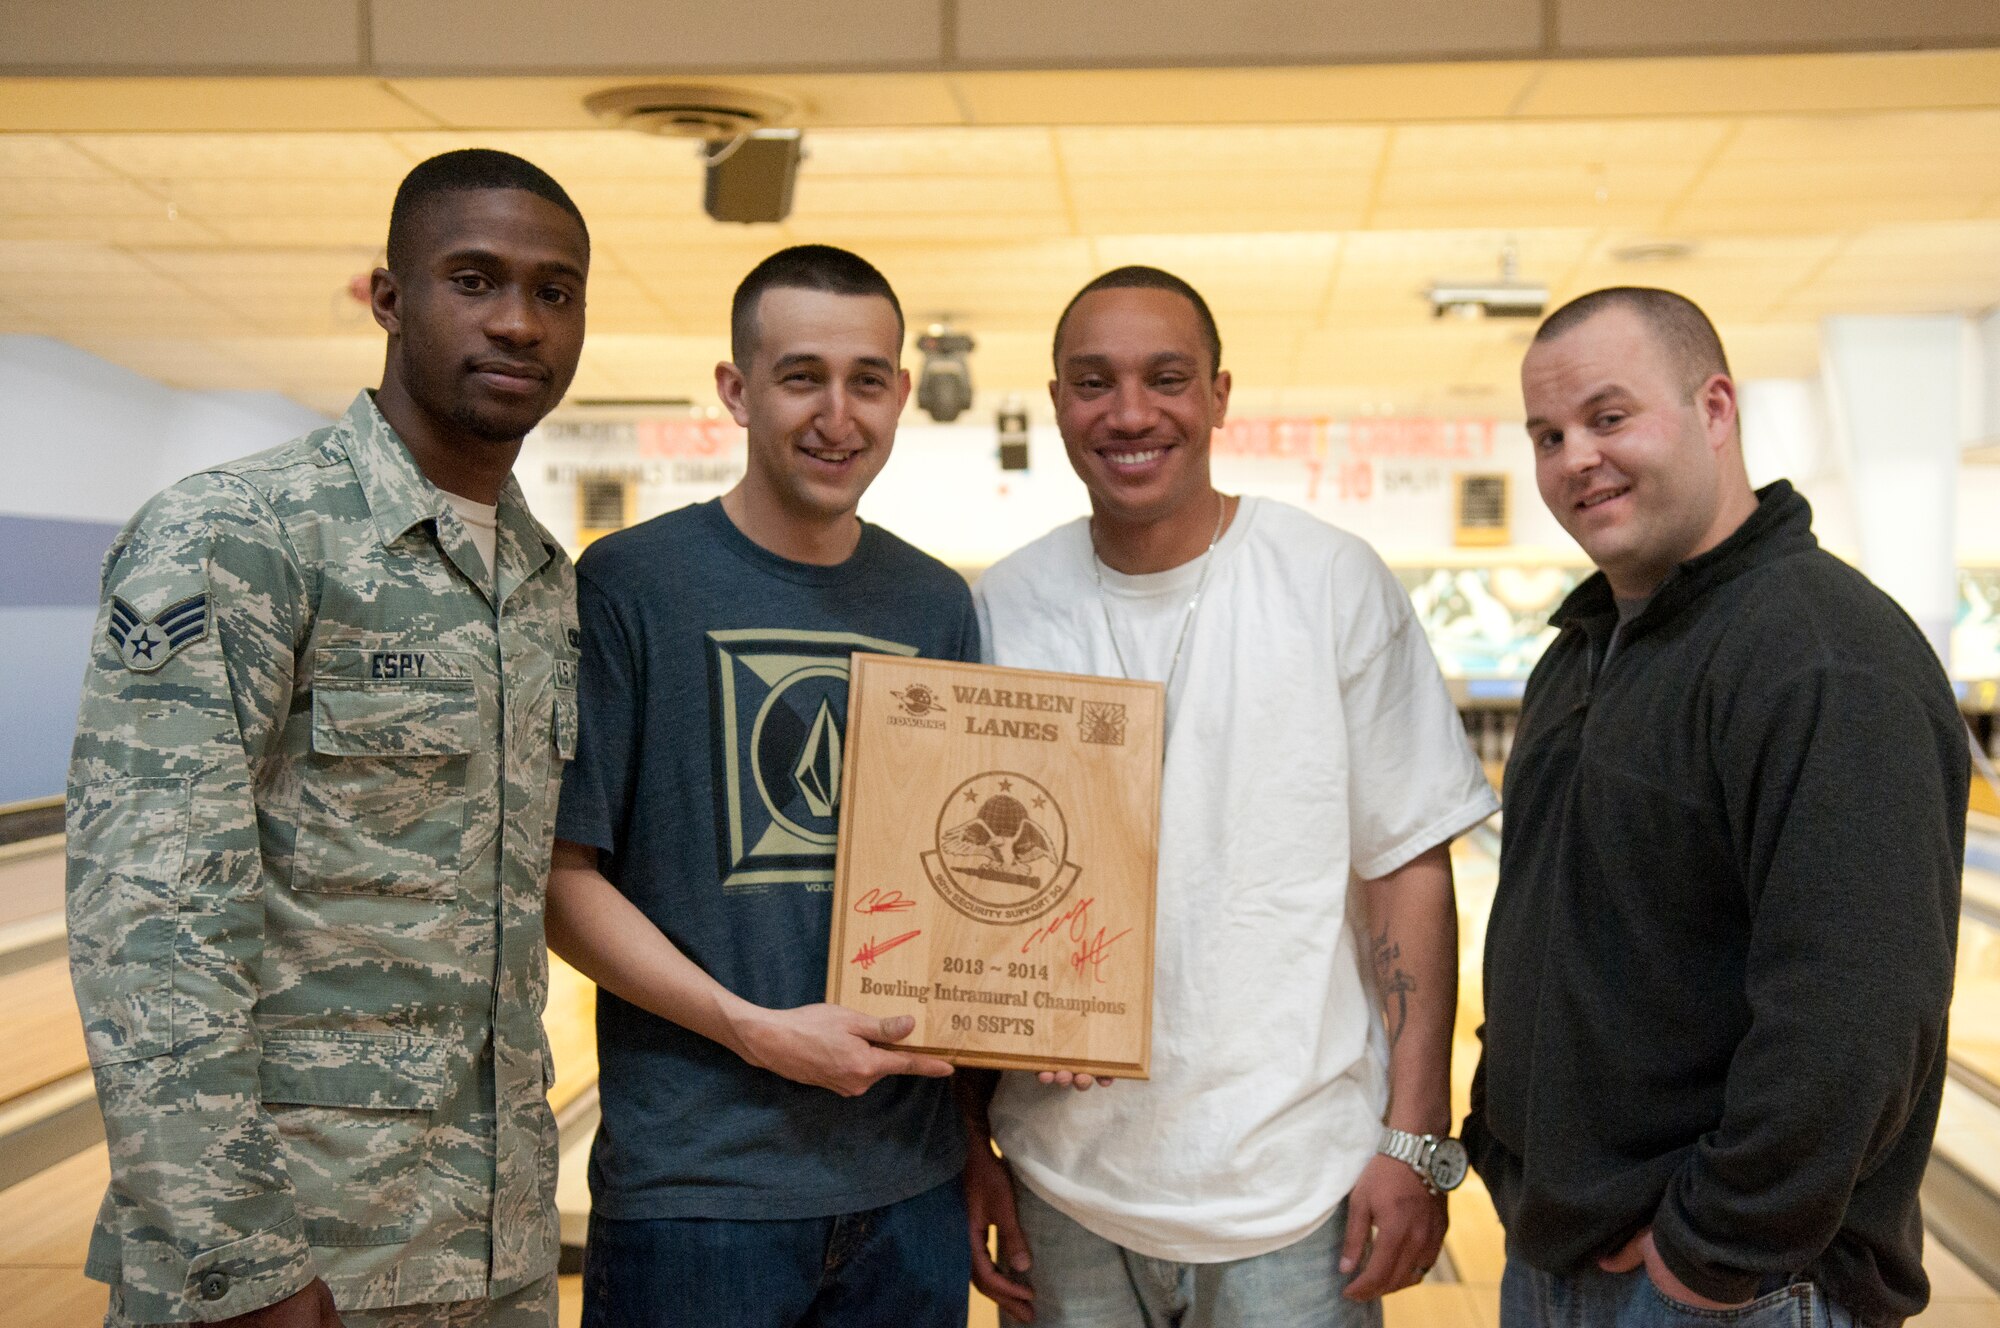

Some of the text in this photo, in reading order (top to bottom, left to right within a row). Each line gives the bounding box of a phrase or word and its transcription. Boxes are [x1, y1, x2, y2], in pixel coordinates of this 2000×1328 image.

[372, 653, 425, 678] ESPY
[952, 685, 1075, 714] WARREN
[964, 716, 1059, 742] LANES
[951, 893, 1003, 918] SECURITY
[1005, 896, 1051, 918] SUPPORT
[943, 957, 984, 975] 2013
[1008, 962, 1049, 980] 2014
[860, 977, 1126, 1017] Bowling Intramural Champions
[951, 1014, 1035, 1036] 90 SSPTS
